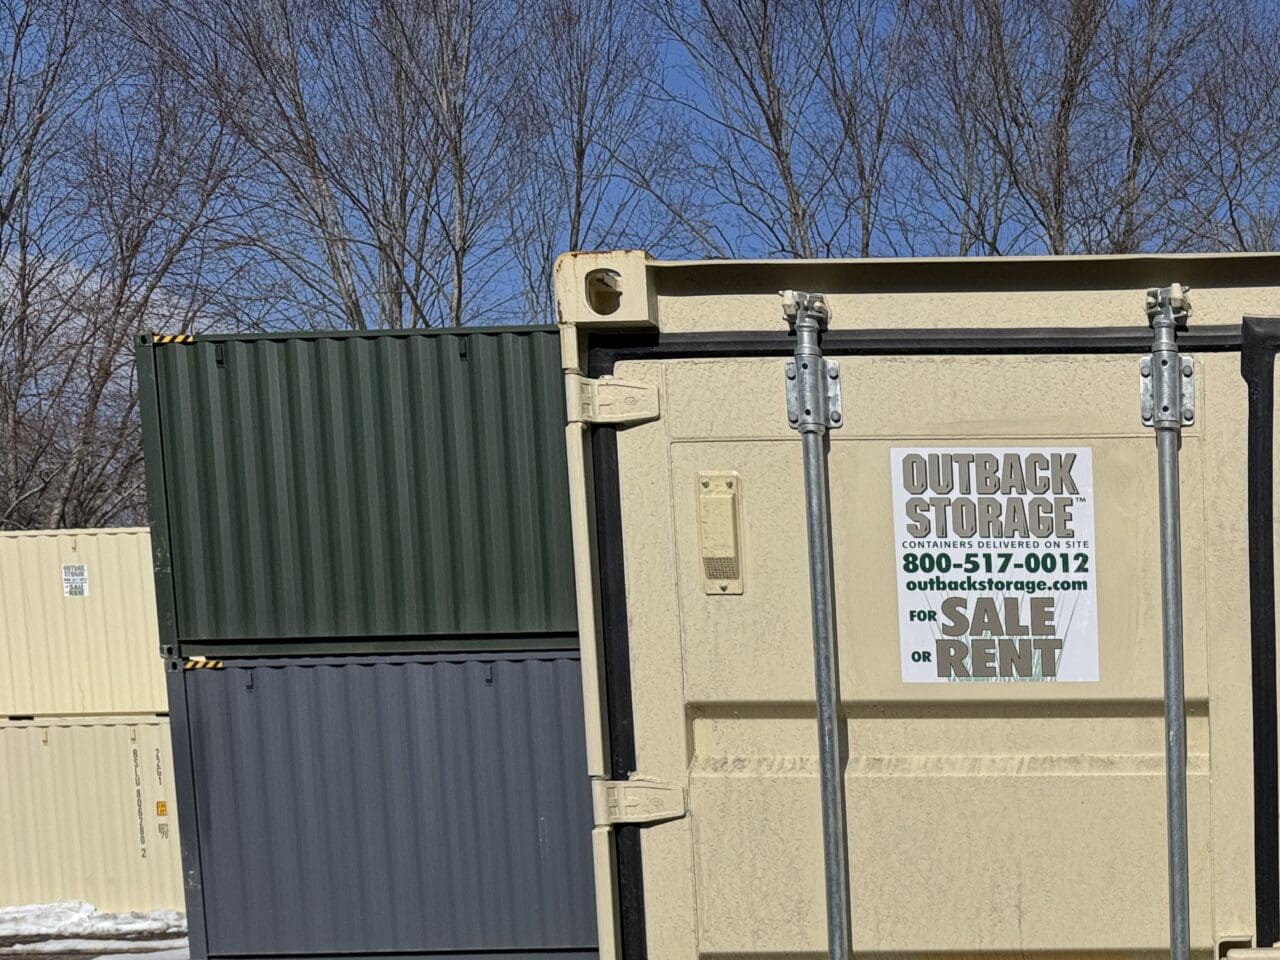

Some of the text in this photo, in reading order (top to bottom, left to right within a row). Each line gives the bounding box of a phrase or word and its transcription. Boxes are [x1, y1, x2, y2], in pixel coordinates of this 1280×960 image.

[902, 453, 1079, 495] OUTBACK
[905, 497, 1075, 539] STORAGE
[902, 541, 1089, 549] CONTAINERS DELIVERED ON SITE
[902, 553, 1089, 573] 800-517-0012
[906, 576, 1088, 594] outbackstorage.com
[909, 596, 1056, 637] FOR SALE
[911, 639, 1063, 677] OR RENT
